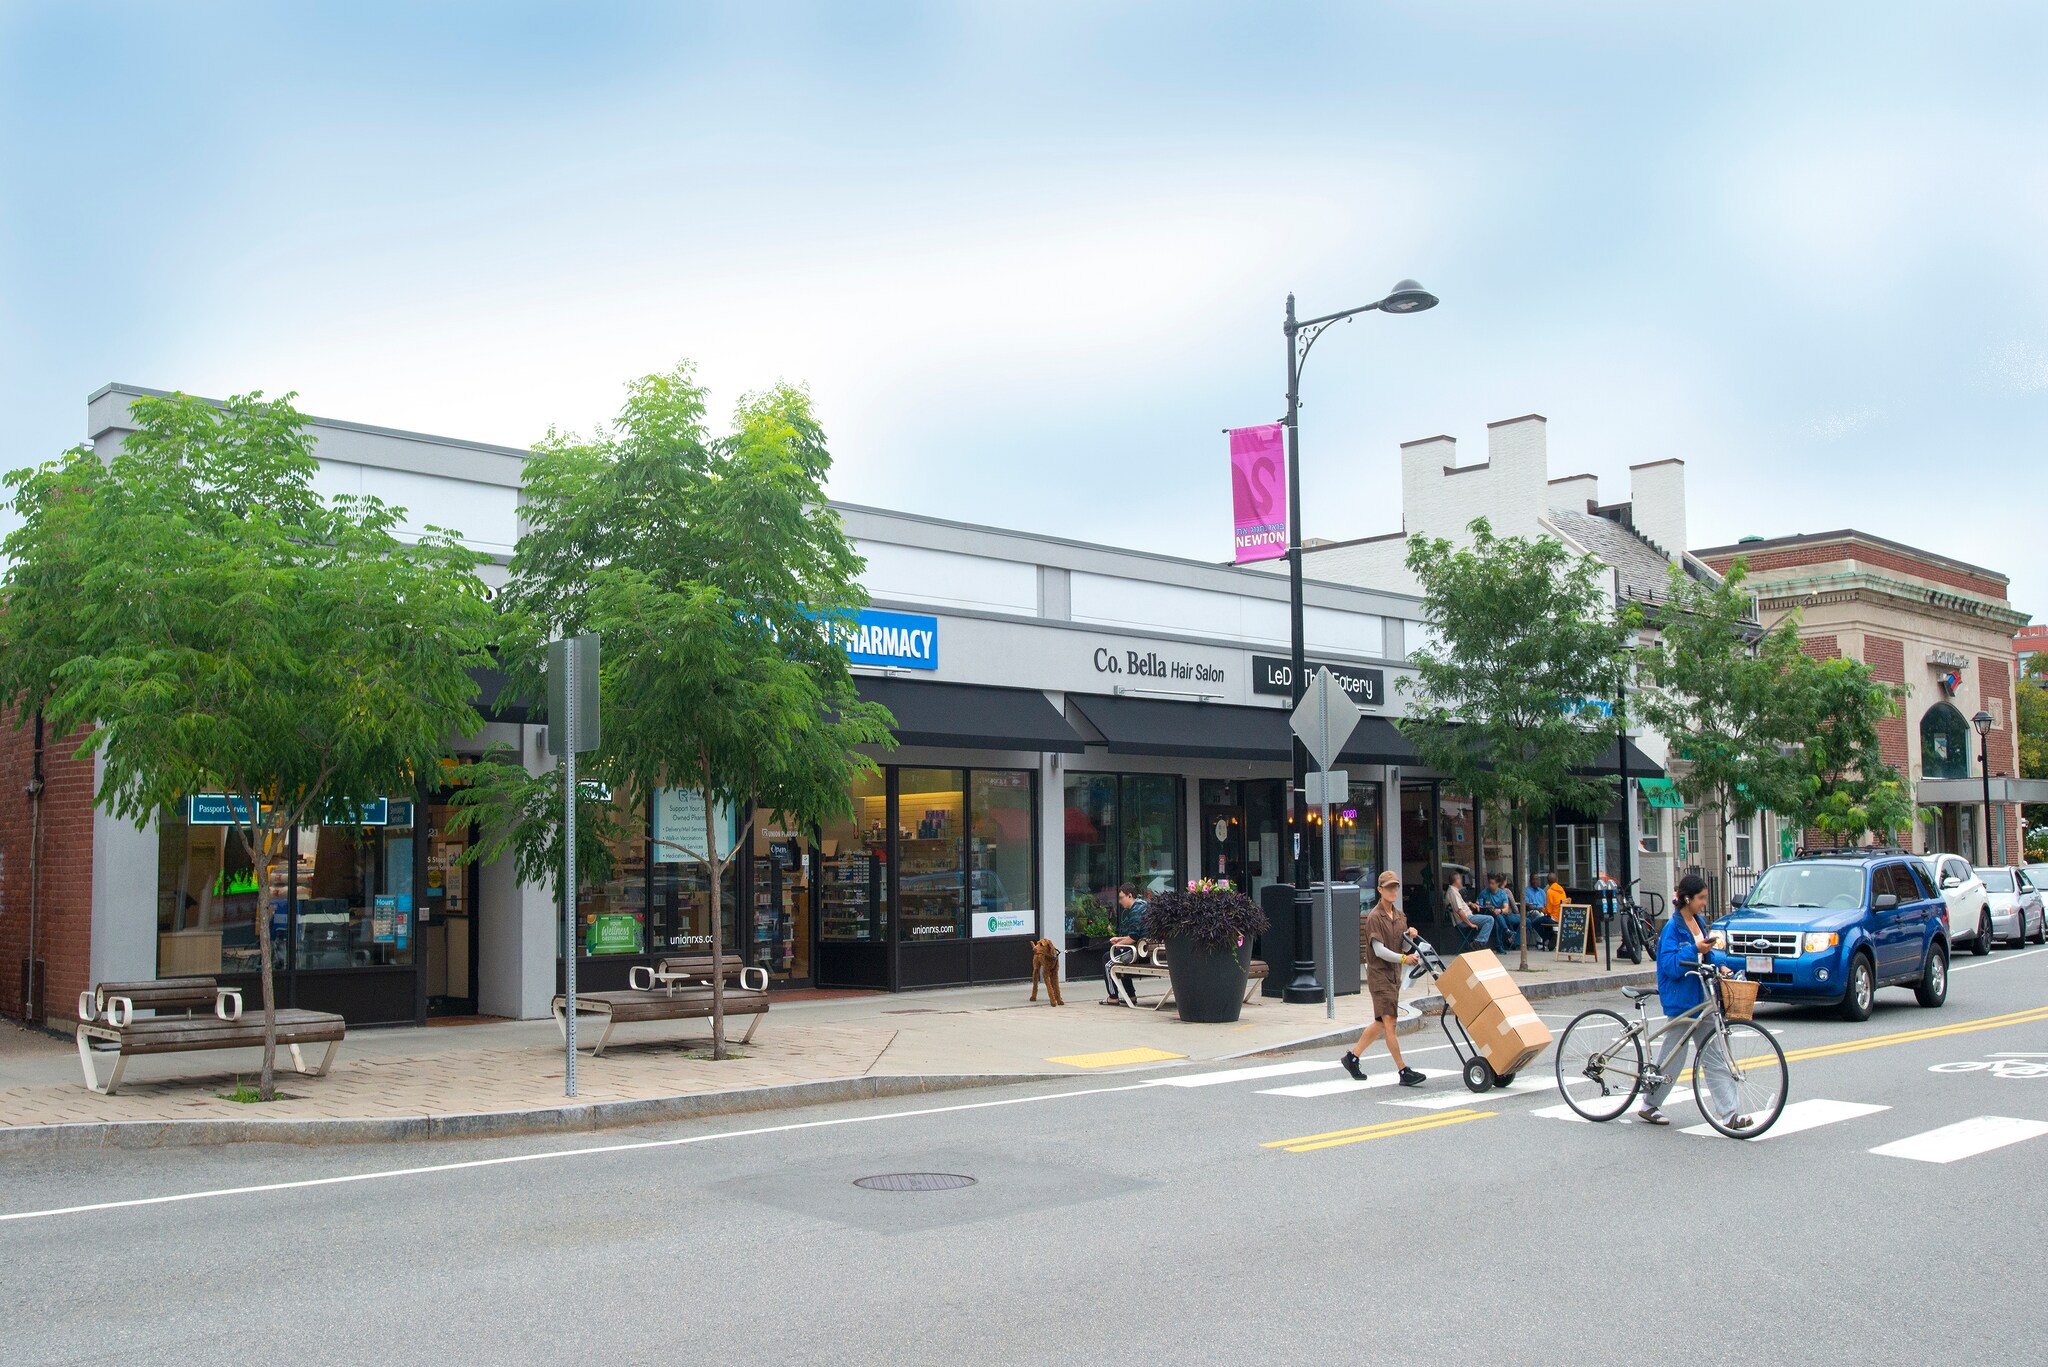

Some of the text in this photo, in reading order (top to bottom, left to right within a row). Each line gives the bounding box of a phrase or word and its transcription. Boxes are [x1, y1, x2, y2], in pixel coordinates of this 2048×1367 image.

[1236, 531, 1285, 548] NEWTON
[1093, 647, 1224, 683] Co. Bella Hair Salon
[1268, 664, 1292, 685] LeD
[198, 805, 225, 814] Passport
[602, 926, 629, 936] Wellness
[912, 924, 953, 935] unionrxs.com
[670, 934, 713, 945] unionrxs.co
